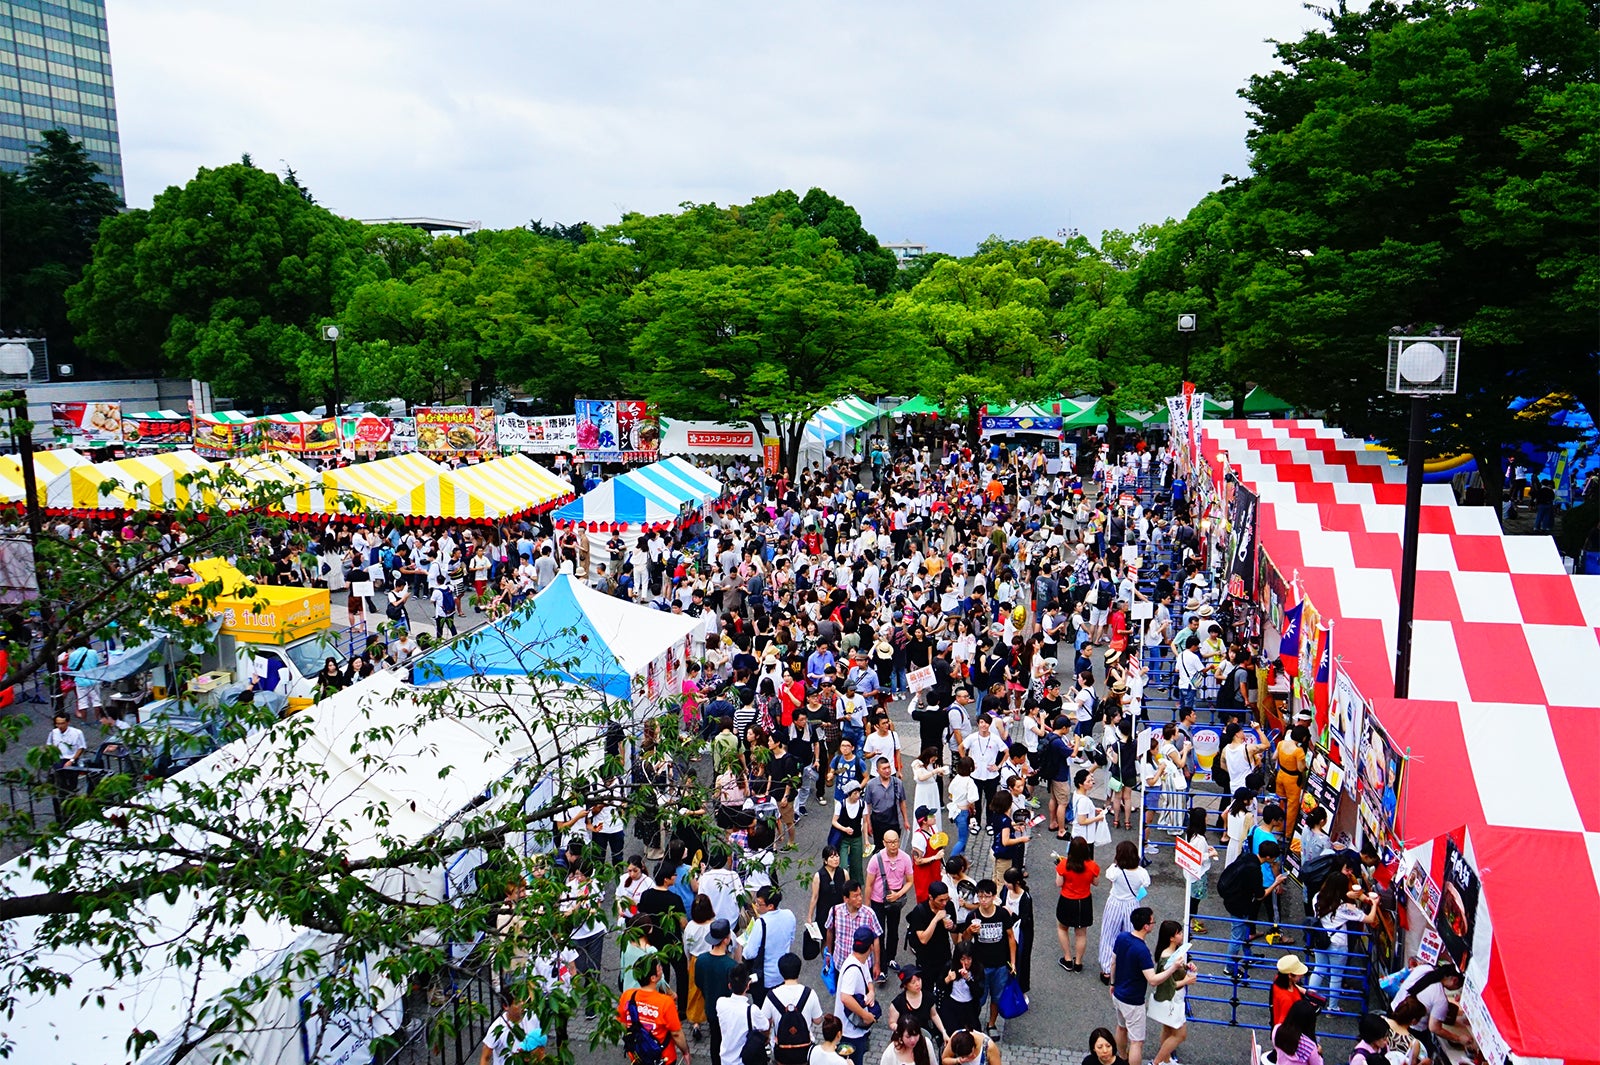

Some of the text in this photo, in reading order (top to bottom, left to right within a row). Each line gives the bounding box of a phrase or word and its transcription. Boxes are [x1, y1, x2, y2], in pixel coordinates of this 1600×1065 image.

[499, 417, 526, 429] 小籠包
[549, 417, 576, 429] 唐揚げ
[619, 416, 629, 449] ラーメン
[699, 435, 743, 443] エコステーション
[1196, 735, 1218, 743] DRY
